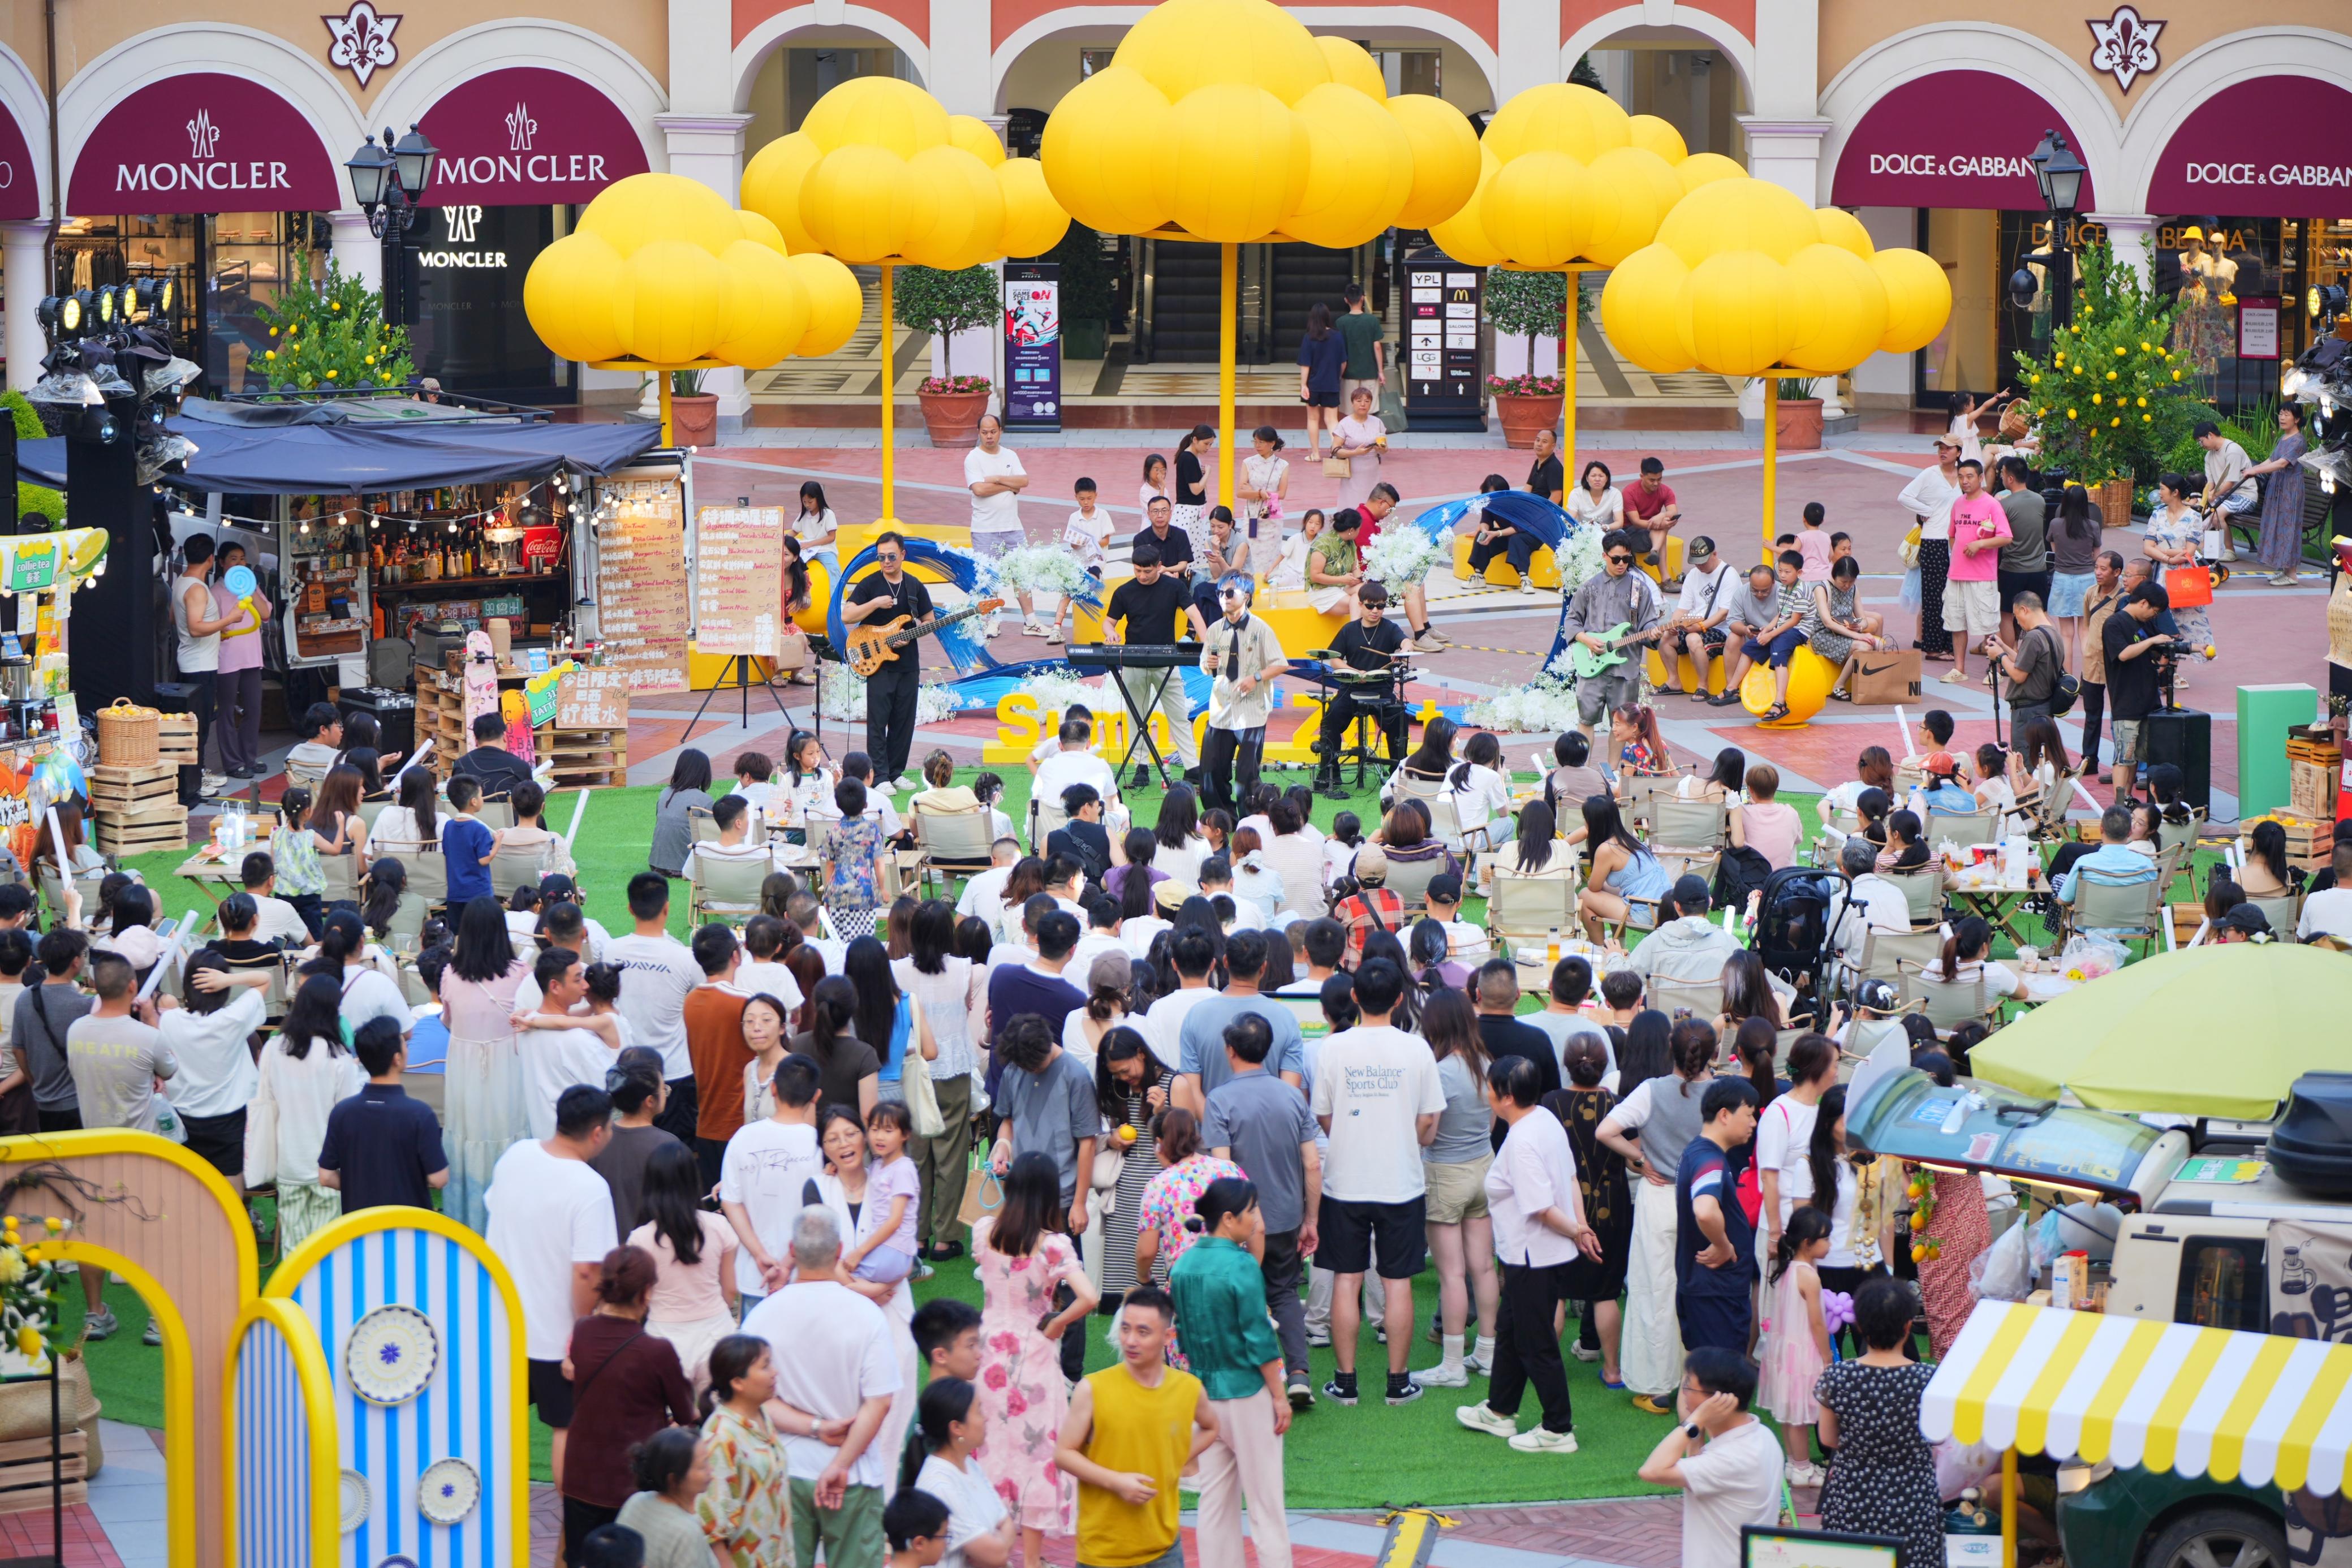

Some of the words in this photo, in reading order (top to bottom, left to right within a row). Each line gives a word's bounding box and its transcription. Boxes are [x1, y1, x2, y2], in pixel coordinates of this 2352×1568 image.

[436, 154, 609, 184] MONCLER
[1870, 153, 1936, 175] DOLCE
[1938, 163, 1947, 176] &
[1949, 155, 2036, 177] GABBAN
[2186, 162, 2256, 184] DOLCE
[2258, 173, 2267, 184] &
[115, 162, 292, 191] MONCLER
[2031, 222, 2105, 247] DLCE
[419, 251, 508, 268] MONCLER
[1415, 275, 1439, 284] YPL
[428, 301, 472, 311] MONCLER
[1416, 352, 1436, 362] UGG
[526, 539, 559, 554] Coca-Cola
[17, 560, 37, 572] collie
[38, 559, 50, 570] tea
[561, 703, 618, 725] 柠檬水
[1344, 1066, 1365, 1078] New
[1346, 1078, 1375, 1093] Sports
[1377, 1076, 1398, 1089] Club
